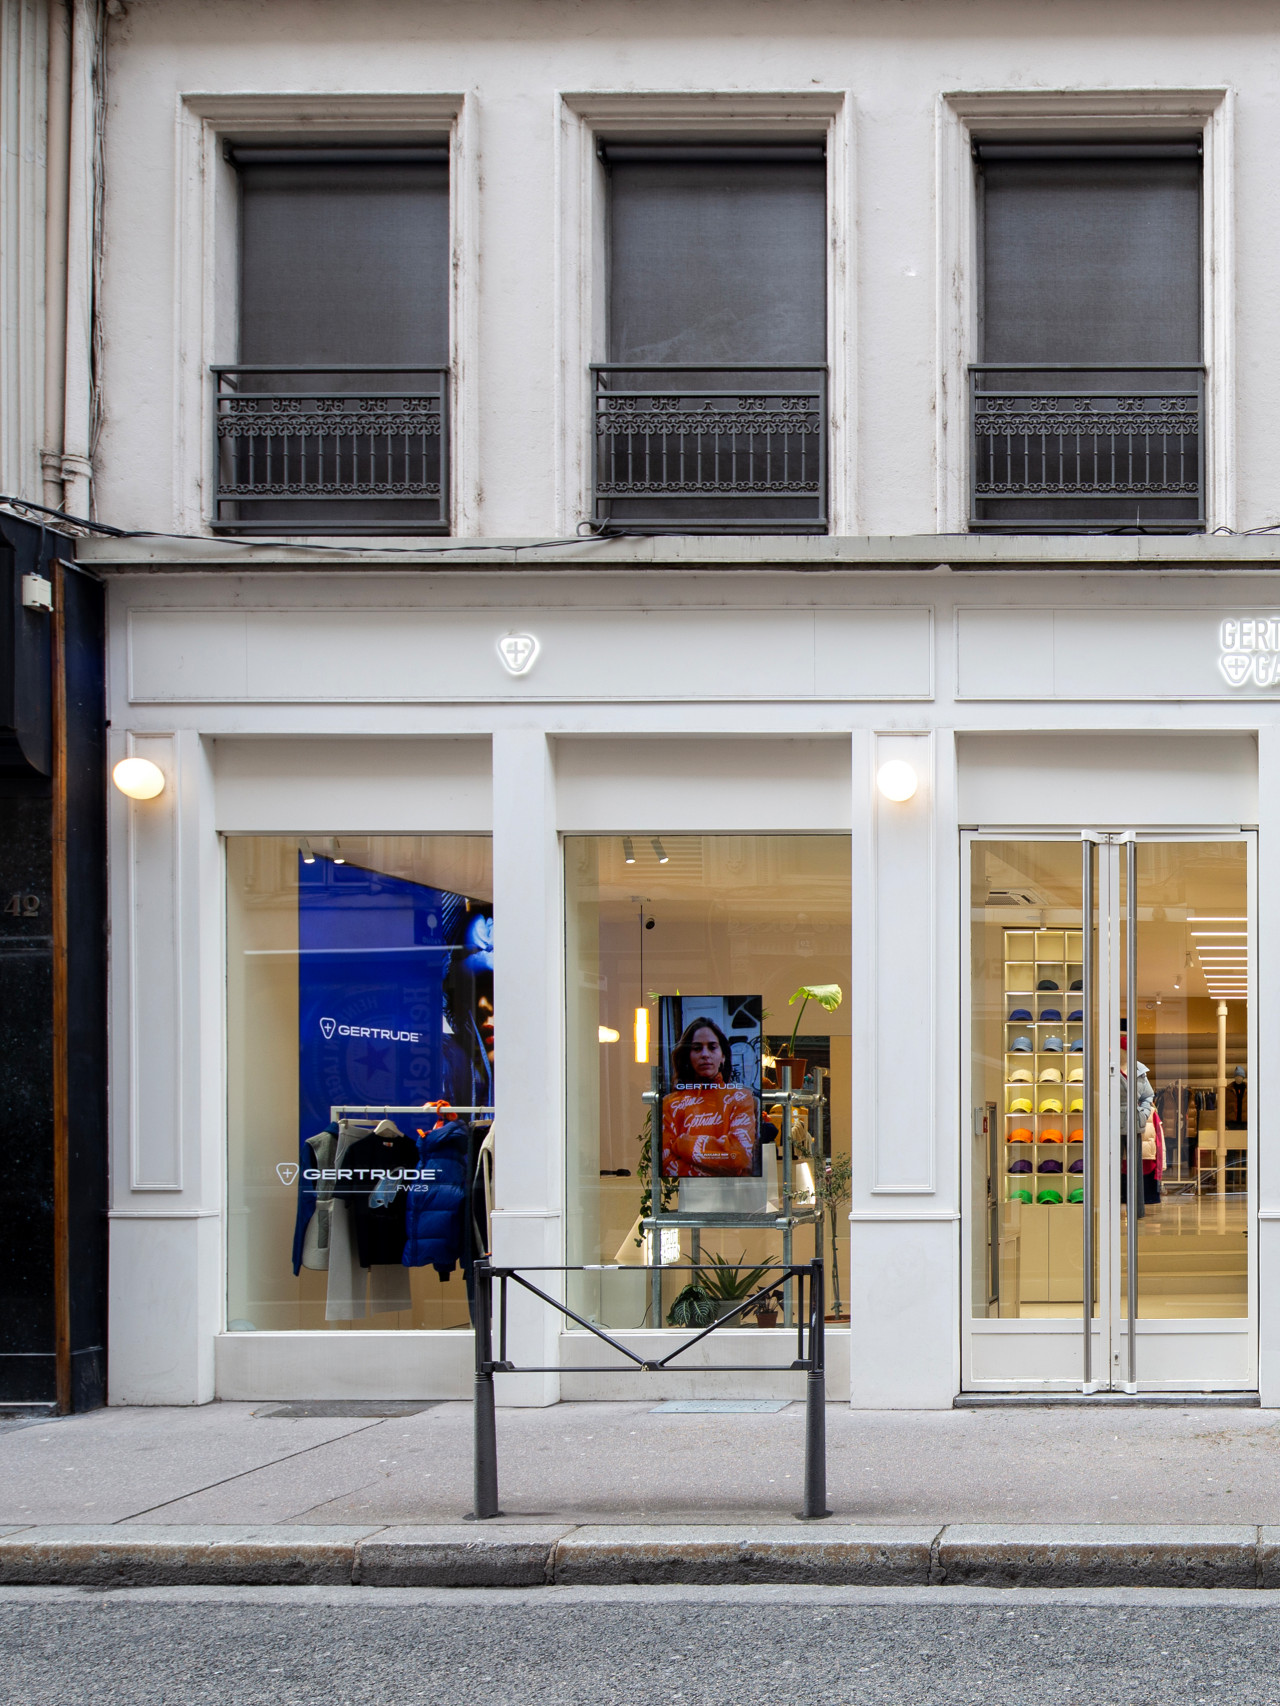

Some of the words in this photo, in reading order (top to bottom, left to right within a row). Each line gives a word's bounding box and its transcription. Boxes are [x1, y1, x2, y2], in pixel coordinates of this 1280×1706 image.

[337, 1024, 420, 1043] GERTRUDE
[303, 1168, 436, 1181] GERTRUDE
[396, 1184, 429, 1193] FW23
